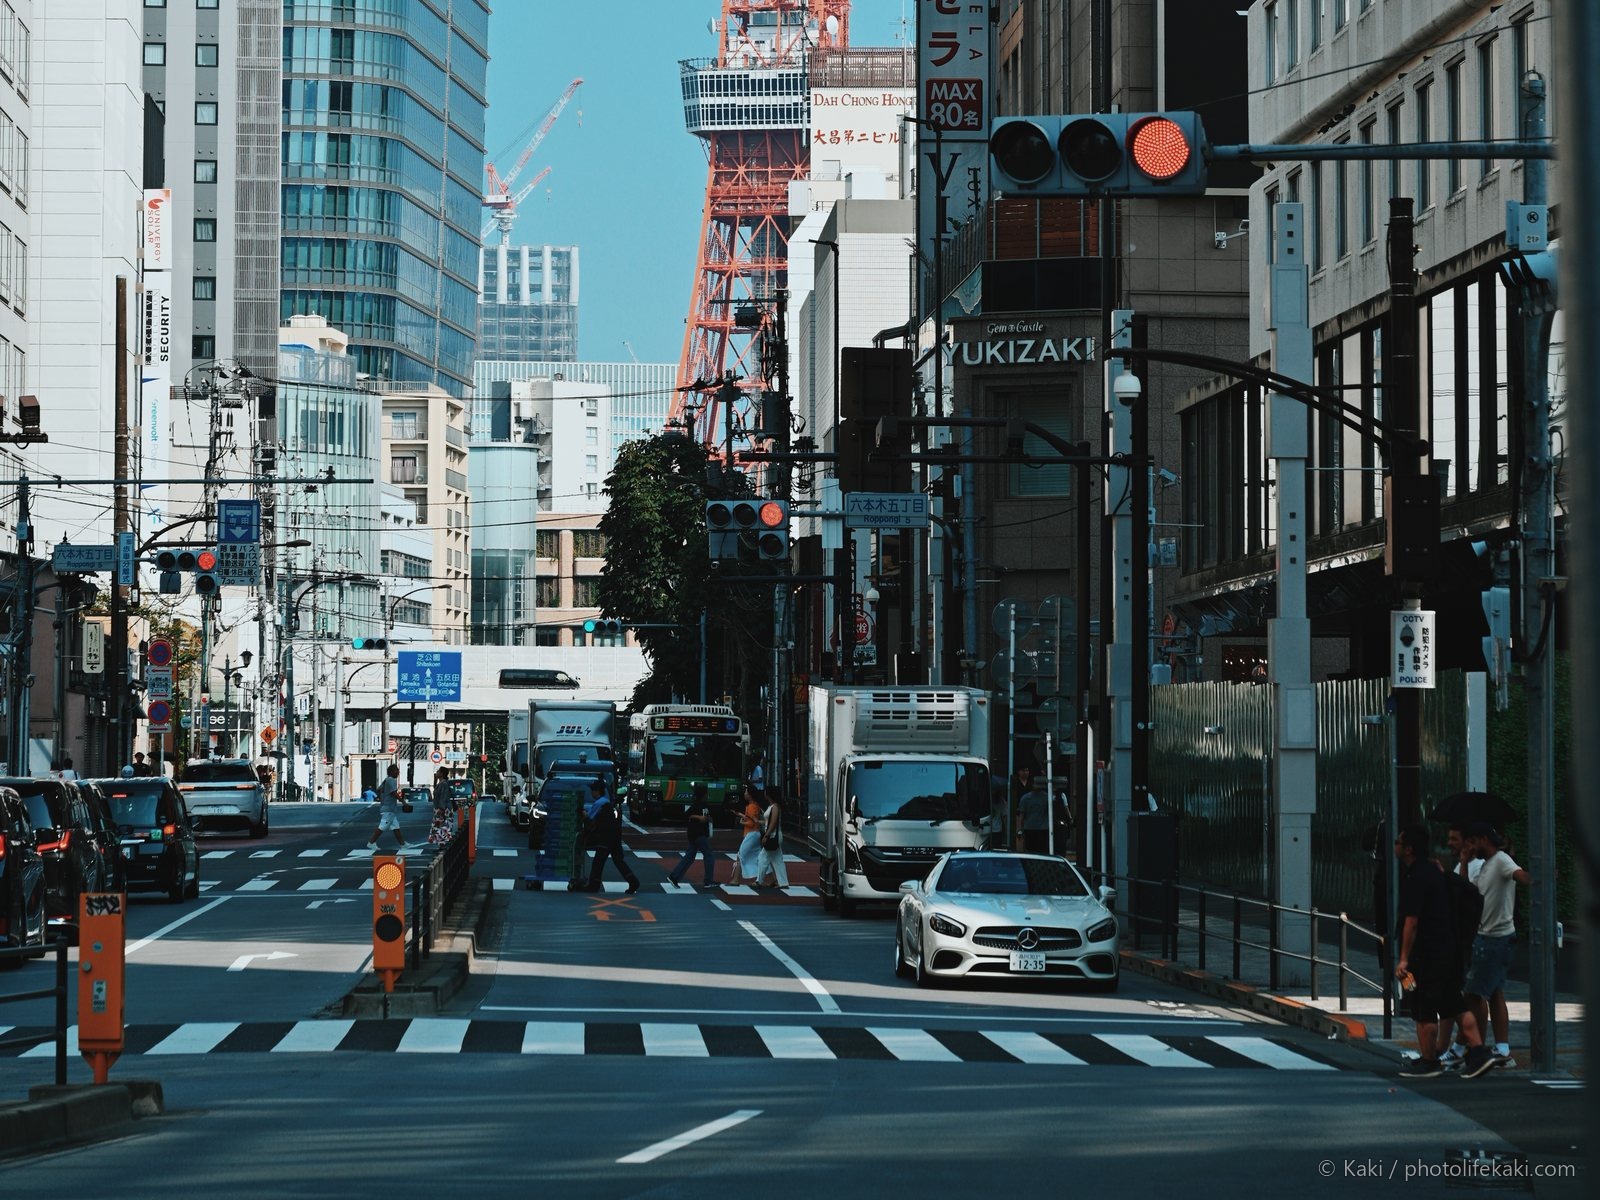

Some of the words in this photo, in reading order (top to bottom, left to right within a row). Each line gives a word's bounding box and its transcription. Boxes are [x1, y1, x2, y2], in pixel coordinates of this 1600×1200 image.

[930, 83, 977, 101] MAX
[930, 102, 979, 128] 80名
[160, 296, 170, 362] SECURITY
[1016, 320, 1044, 333] Castle
[942, 336, 1096, 366] YUKIZAKI
[851, 498, 924, 513] 六本木五丁目
[864, 515, 900, 524] Roppongi
[905, 516, 911, 524] 5
[57, 549, 113, 560] 六本木五丁目
[1402, 615, 1424, 623] CCTV
[436, 673, 460, 682] 五反田
[1400, 676, 1428, 684] POLICE
[556, 725, 584, 734] JUL
[1018, 960, 1044, 970] 12-35
